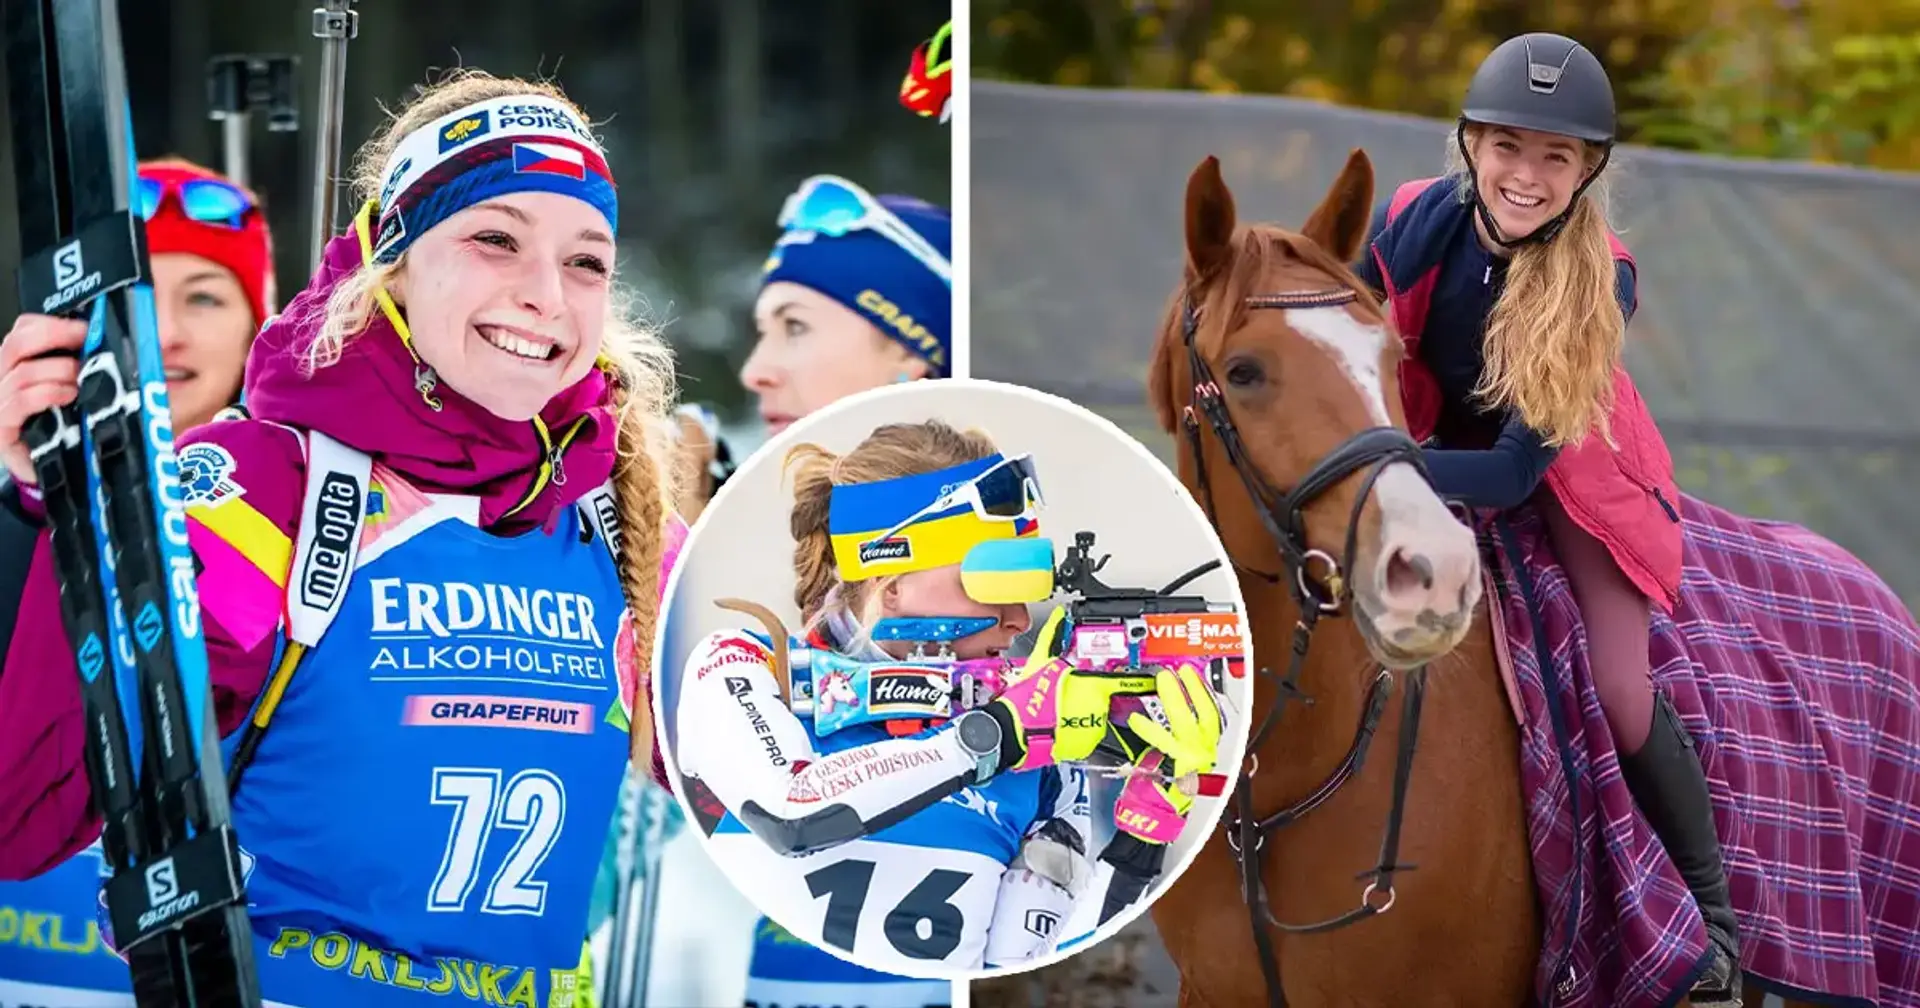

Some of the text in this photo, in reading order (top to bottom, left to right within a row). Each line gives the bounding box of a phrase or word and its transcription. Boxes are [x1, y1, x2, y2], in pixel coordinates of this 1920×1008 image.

[306, 479, 356, 600] meopta
[369, 577, 605, 650] ERDINGER
[369, 645, 607, 680] ALKOHOLFREI
[431, 702, 579, 727] GRAPEFRUIT
[724, 677, 787, 767] ALPINE PRO
[427, 767, 567, 917] 72
[803, 858, 973, 961] 16
[269, 927, 538, 1008] POKLJUKA
